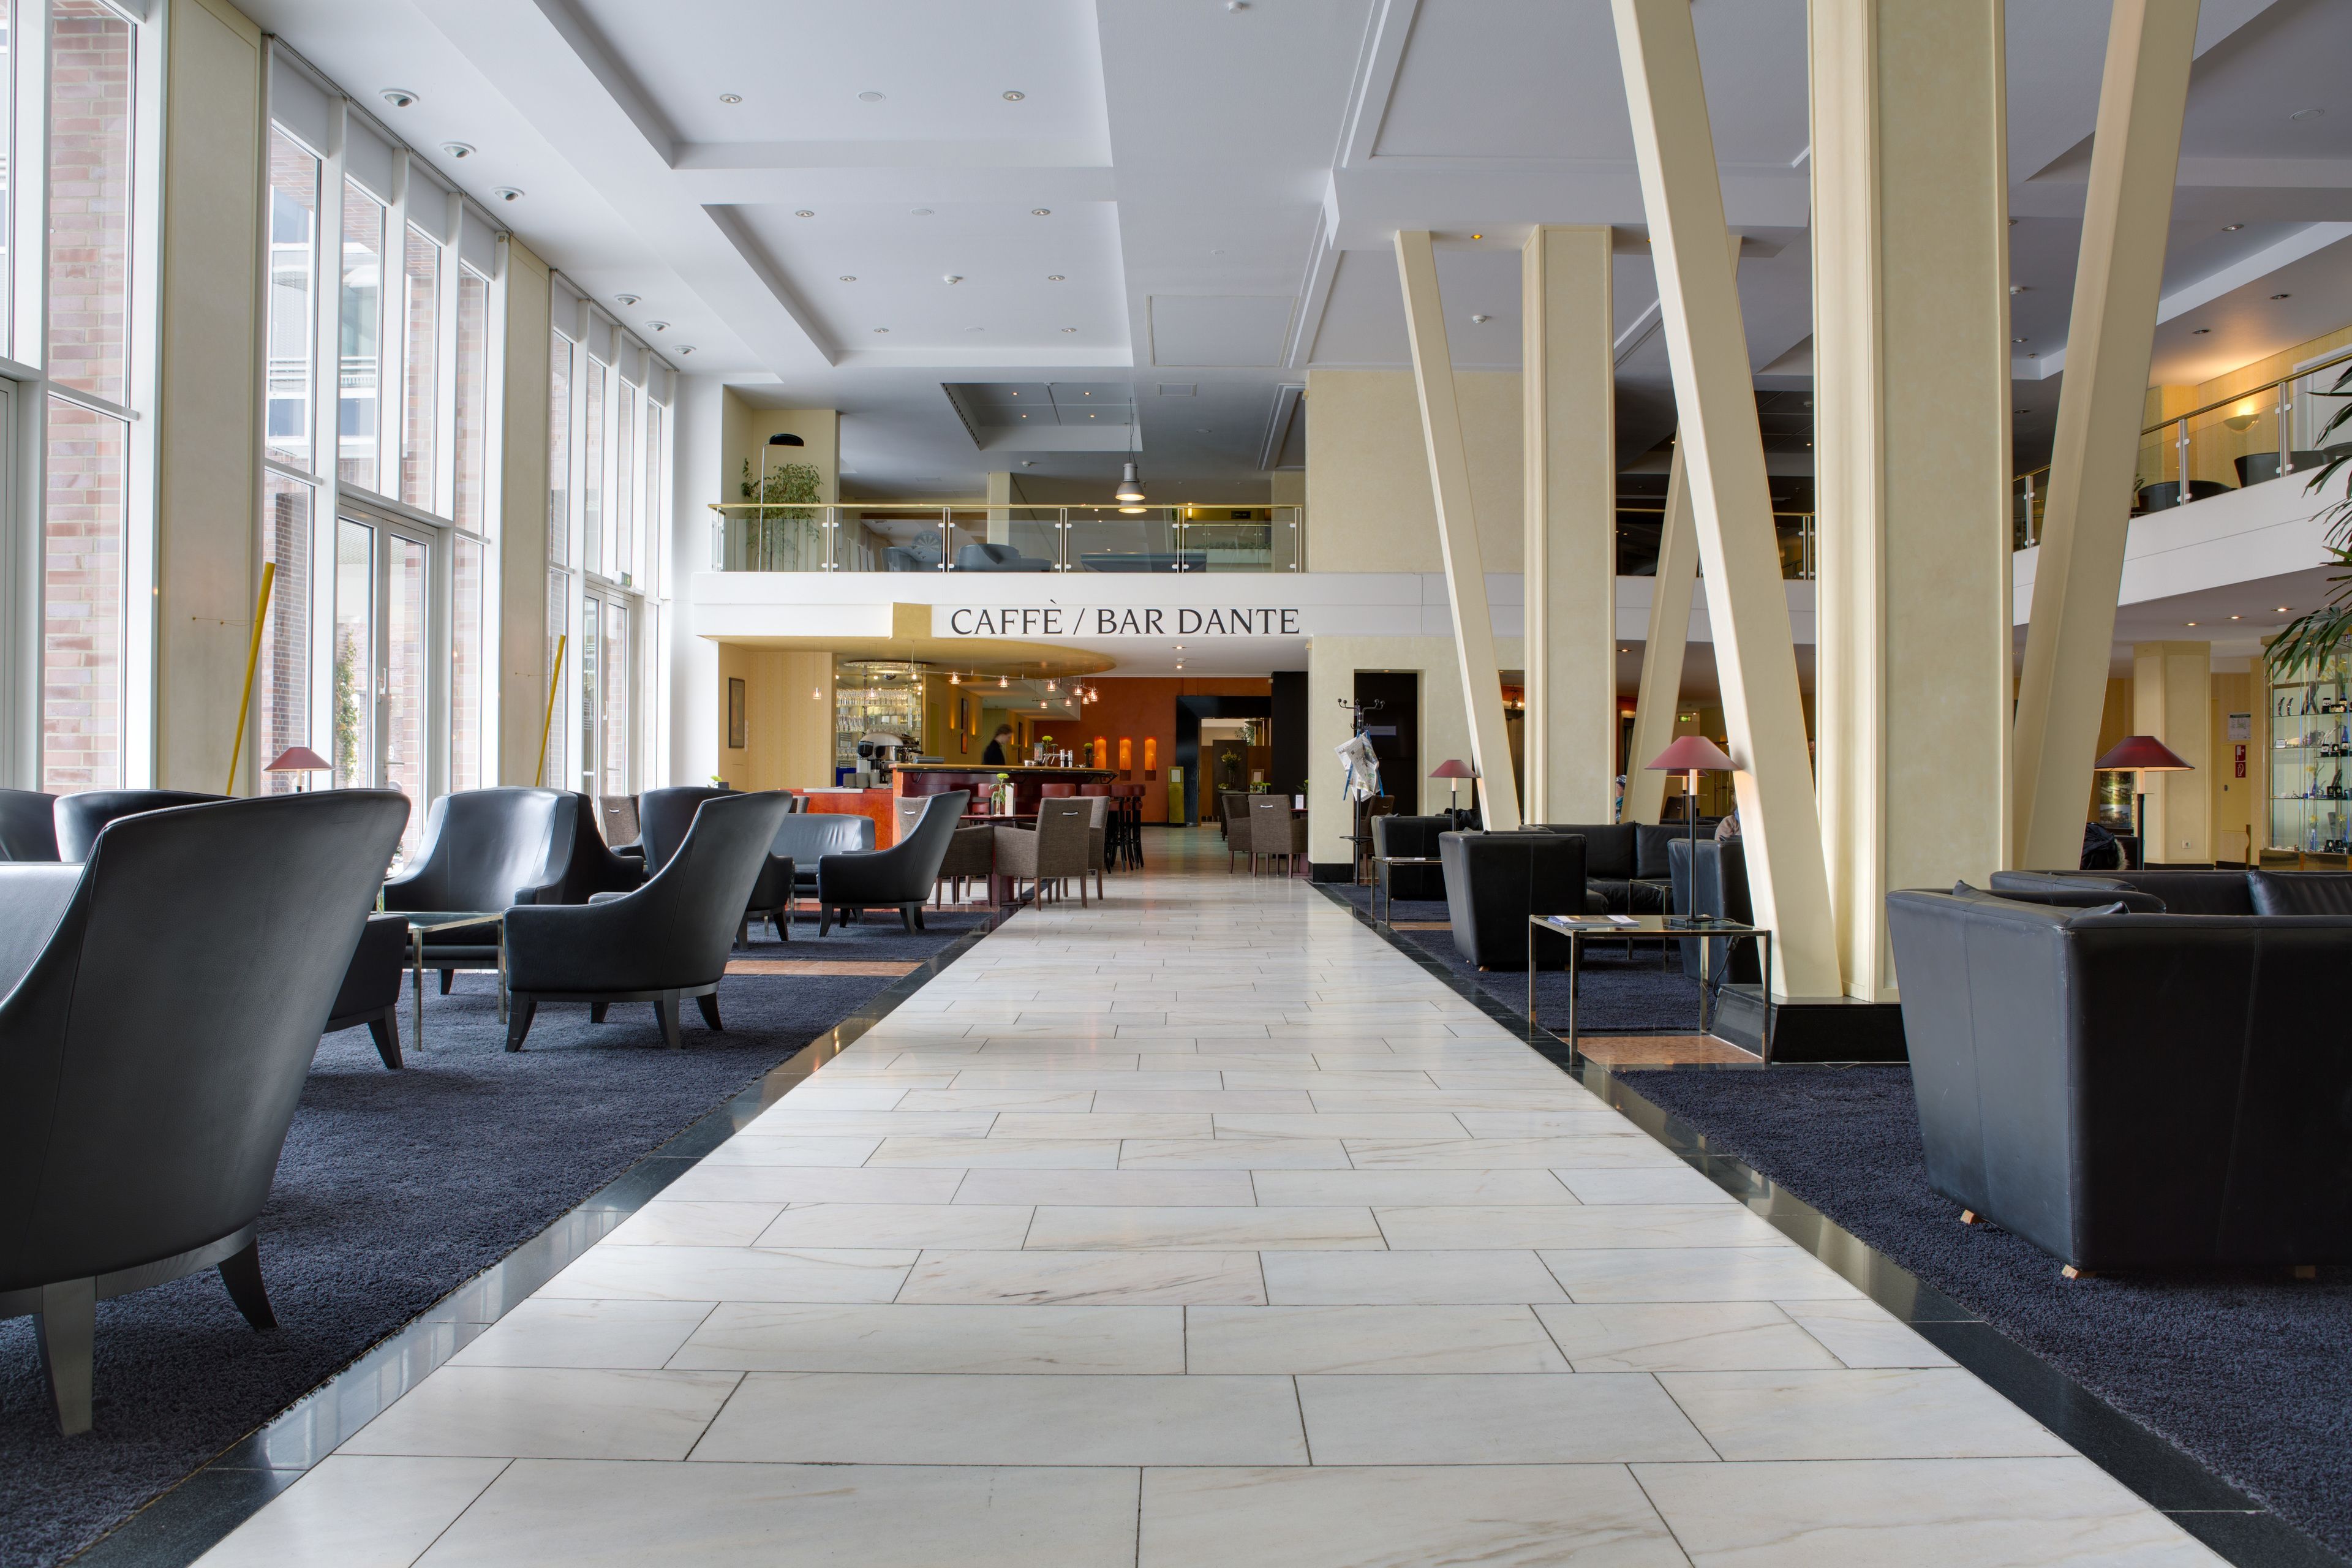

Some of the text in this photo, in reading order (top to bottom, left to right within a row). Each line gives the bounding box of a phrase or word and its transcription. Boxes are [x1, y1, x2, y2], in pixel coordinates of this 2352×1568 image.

[951, 599, 1300, 635] CAFFÈ / BAR DANTE
